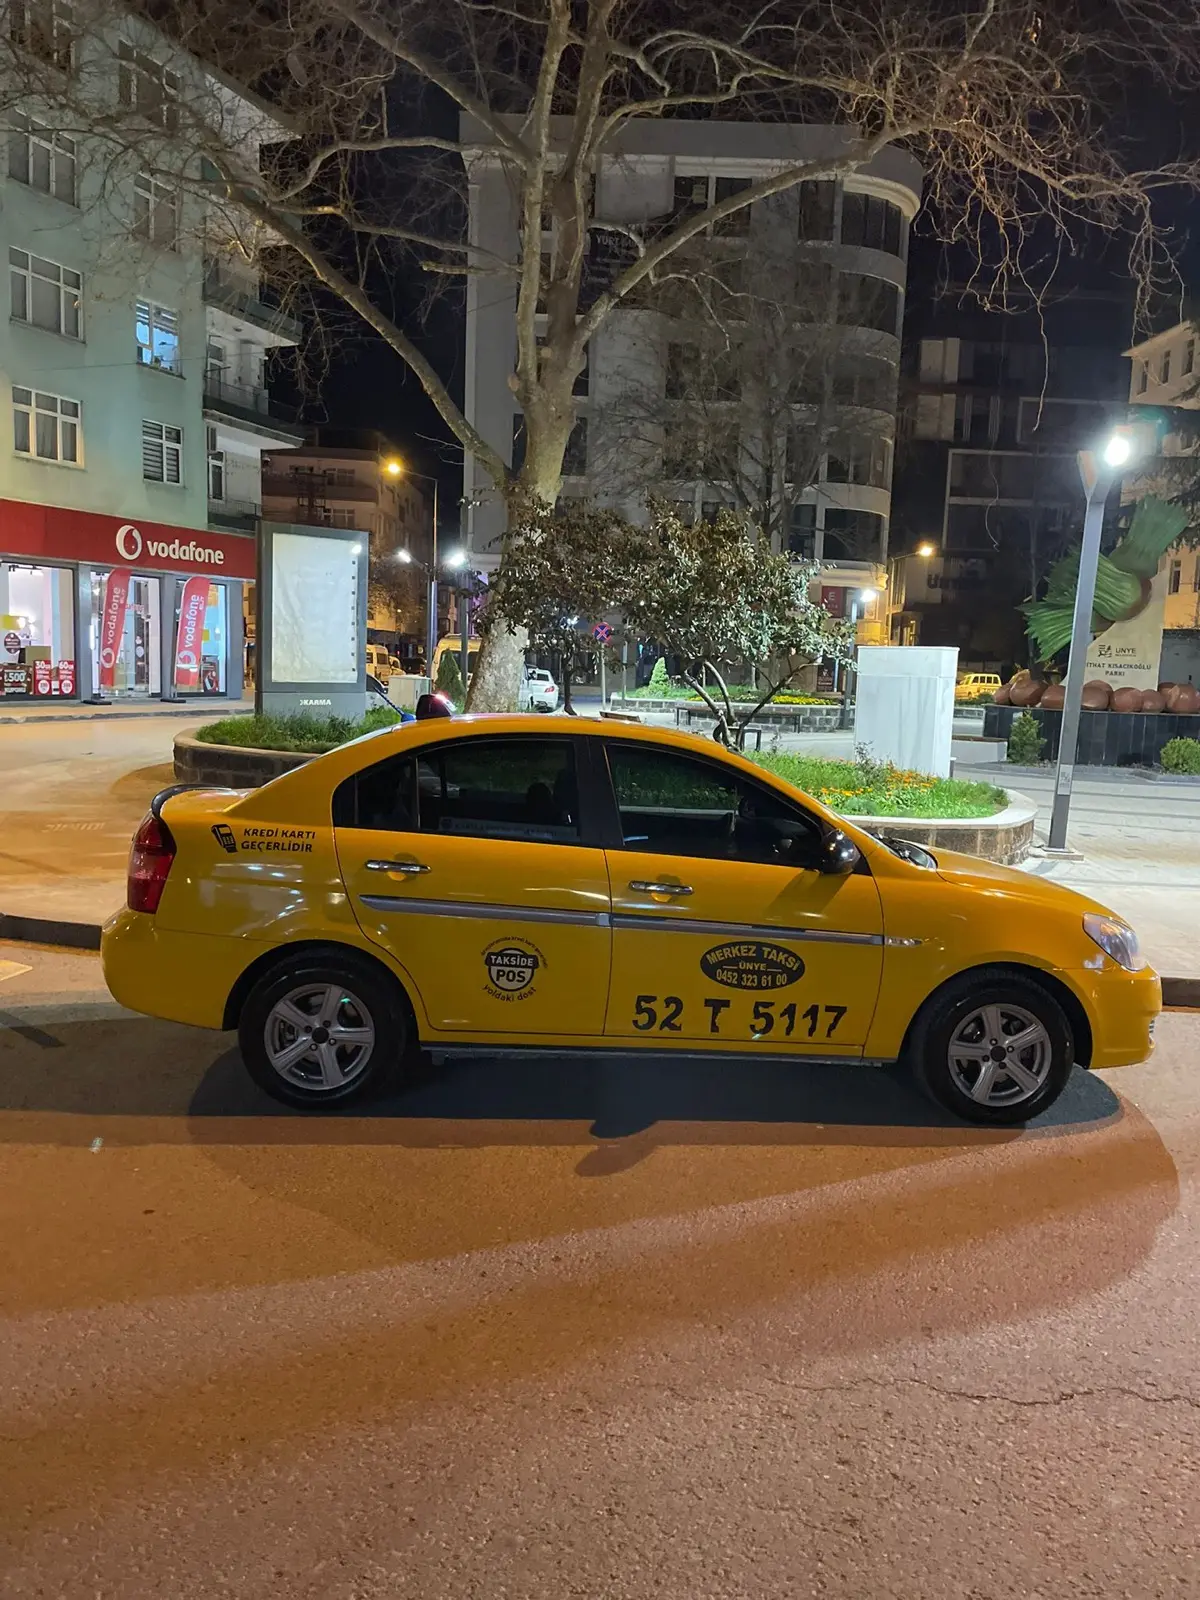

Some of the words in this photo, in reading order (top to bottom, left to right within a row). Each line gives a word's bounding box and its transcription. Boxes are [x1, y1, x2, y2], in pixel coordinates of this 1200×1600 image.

[146, 539, 224, 565] vodafone
[107, 587, 121, 645] vodafone
[184, 594, 200, 648] vodafone
[243, 828, 279, 838] KREDİ
[281, 829, 316, 840] KARTI
[241, 840, 313, 853] GEÇERLİDİR
[490, 955, 534, 967] TAKSİDE
[706, 945, 757, 965] MERKEZ
[738, 960, 767, 971] ÜNYE
[495, 969, 526, 983] POS
[716, 969, 738, 985] 0452
[741, 973, 758, 987] 323
[761, 974, 772, 987] 61
[776, 973, 788, 985] 00
[482, 984, 514, 1002] yoldaki
[517, 986, 537, 1001] dost
[632, 995, 684, 1031] 52
[704, 998, 731, 1033] T
[749, 1001, 848, 1038] 5117
